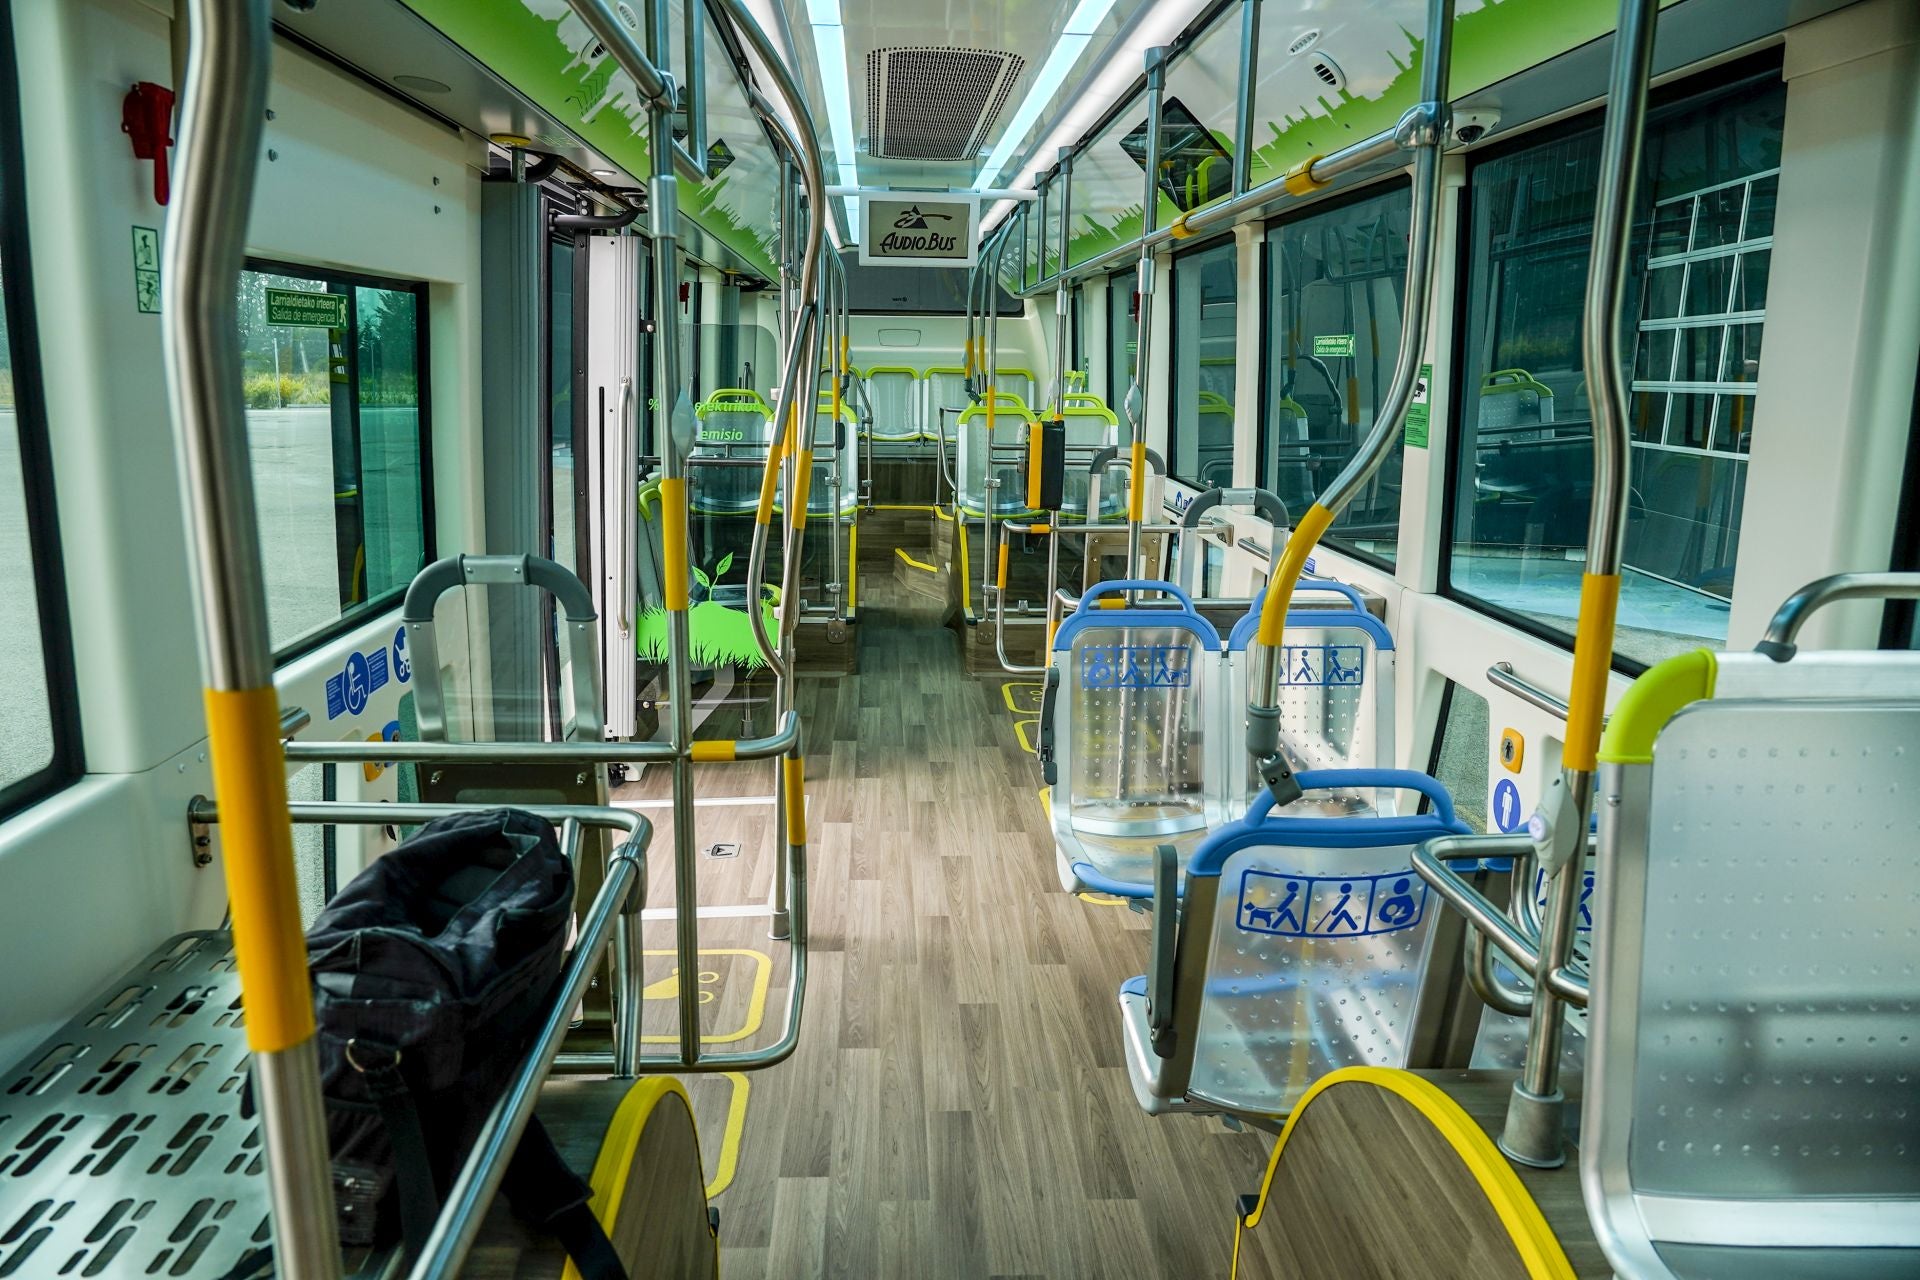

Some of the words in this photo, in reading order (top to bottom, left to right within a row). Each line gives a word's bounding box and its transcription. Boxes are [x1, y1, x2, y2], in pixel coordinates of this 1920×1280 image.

[271, 292, 315, 309] Larrialdietako
[272, 307, 292, 320] Salida
[293, 308, 302, 320] de
[303, 311, 336, 325] emergencia
[701, 428, 743, 441] emisio
